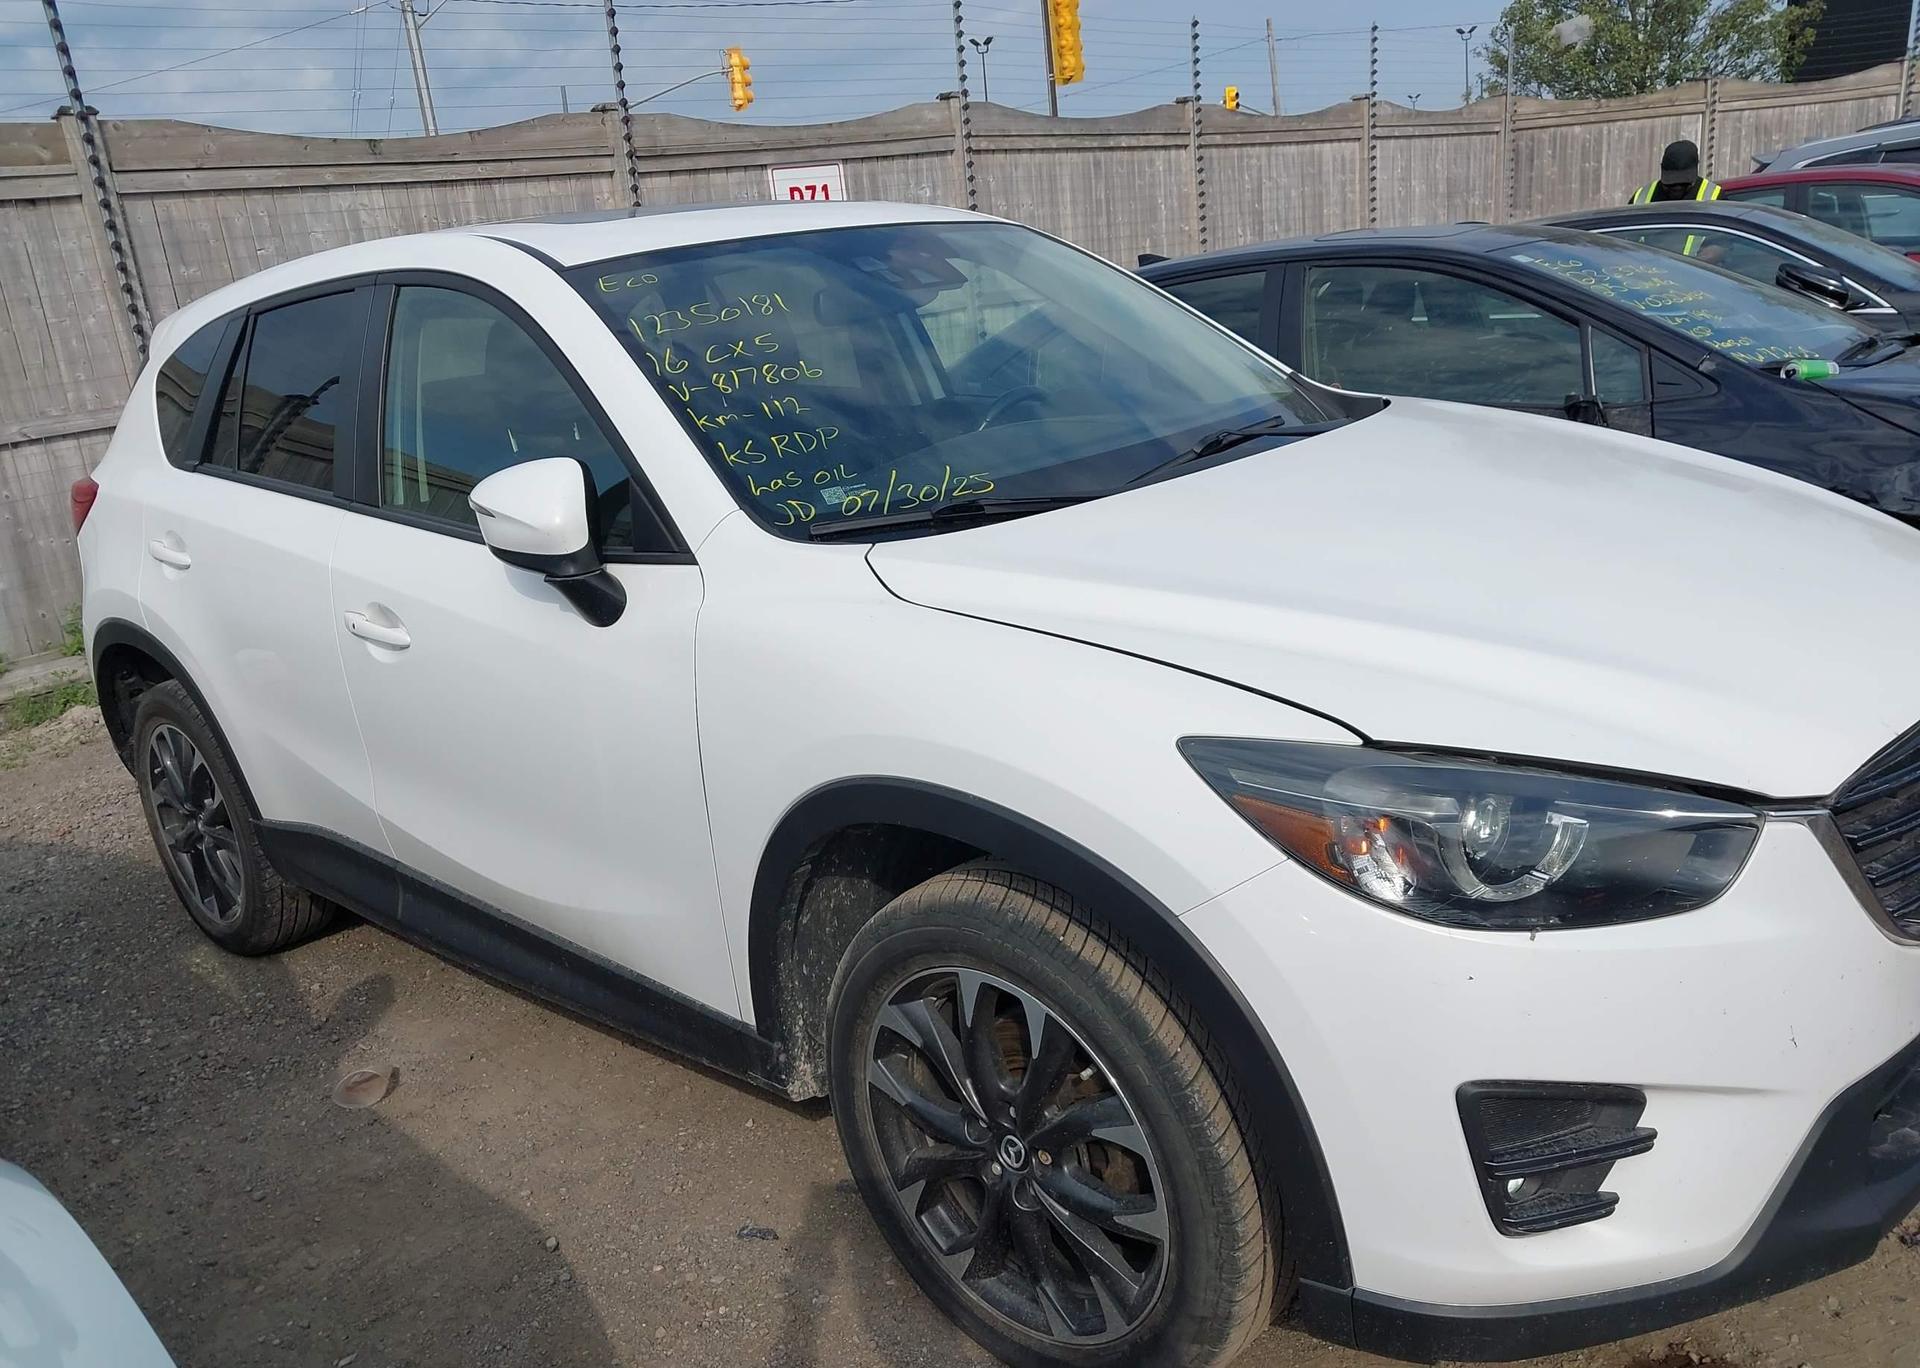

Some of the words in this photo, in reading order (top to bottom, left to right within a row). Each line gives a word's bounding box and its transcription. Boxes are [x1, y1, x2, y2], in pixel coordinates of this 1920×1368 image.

[629, 292, 791, 342] 12350181
[645, 347, 688, 376] 16
[770, 427, 839, 458] RDP
[841, 465, 995, 516] 07/30/25
